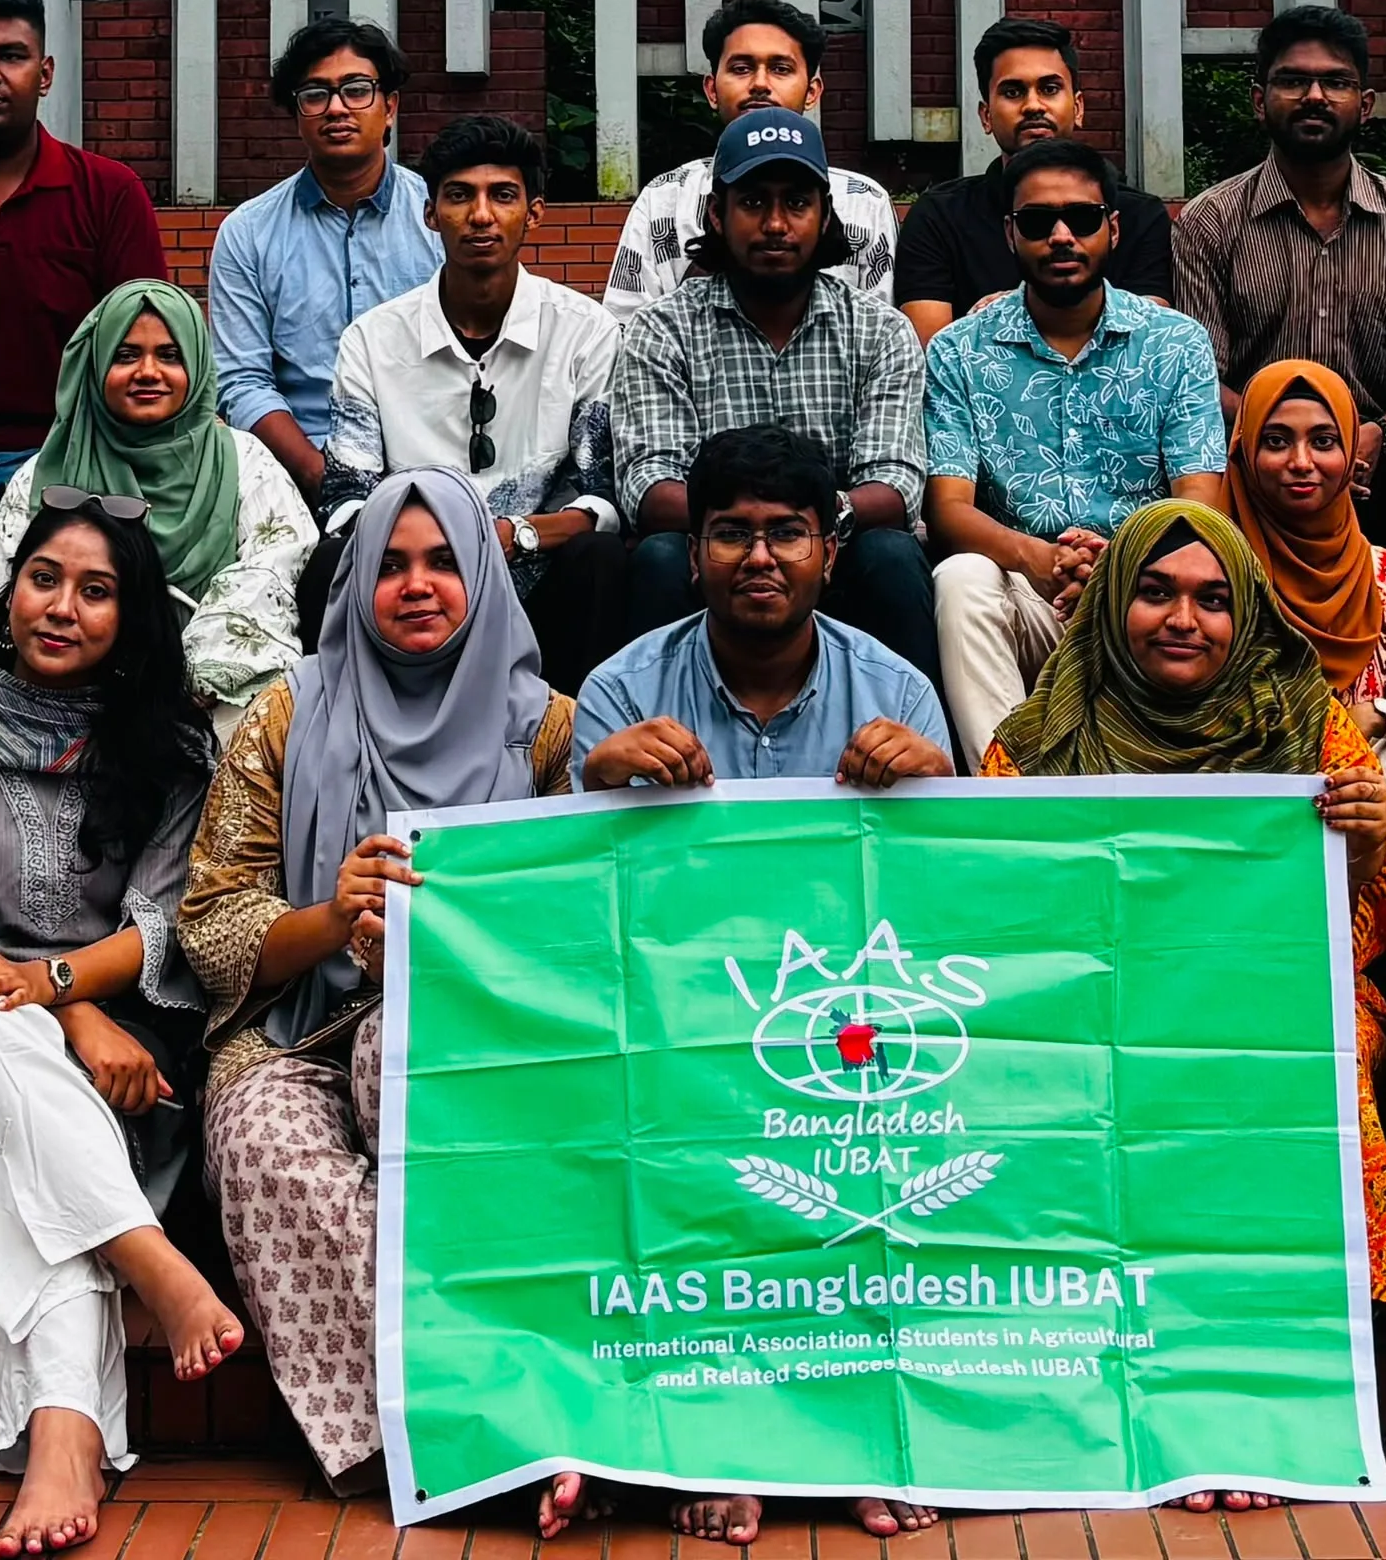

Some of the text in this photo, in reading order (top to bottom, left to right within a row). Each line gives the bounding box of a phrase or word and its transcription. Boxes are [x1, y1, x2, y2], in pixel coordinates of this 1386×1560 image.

[747, 127, 803, 147] BOSS
[724, 918, 990, 1011] IAAS
[763, 1101, 967, 1147] Bangladesh
[814, 1146, 920, 1176] IUBAT
[589, 1262, 1155, 1316] IAAS Bangladesh IUBAT
[592, 1332, 736, 1359] International
[741, 1329, 872, 1353] Association
[897, 1327, 999, 1348] Students
[1003, 1328, 1024, 1346] in
[1028, 1326, 1156, 1349] Agricultural
[655, 1356, 1101, 1388] and Related Sciences Bangladesh IUBAT
